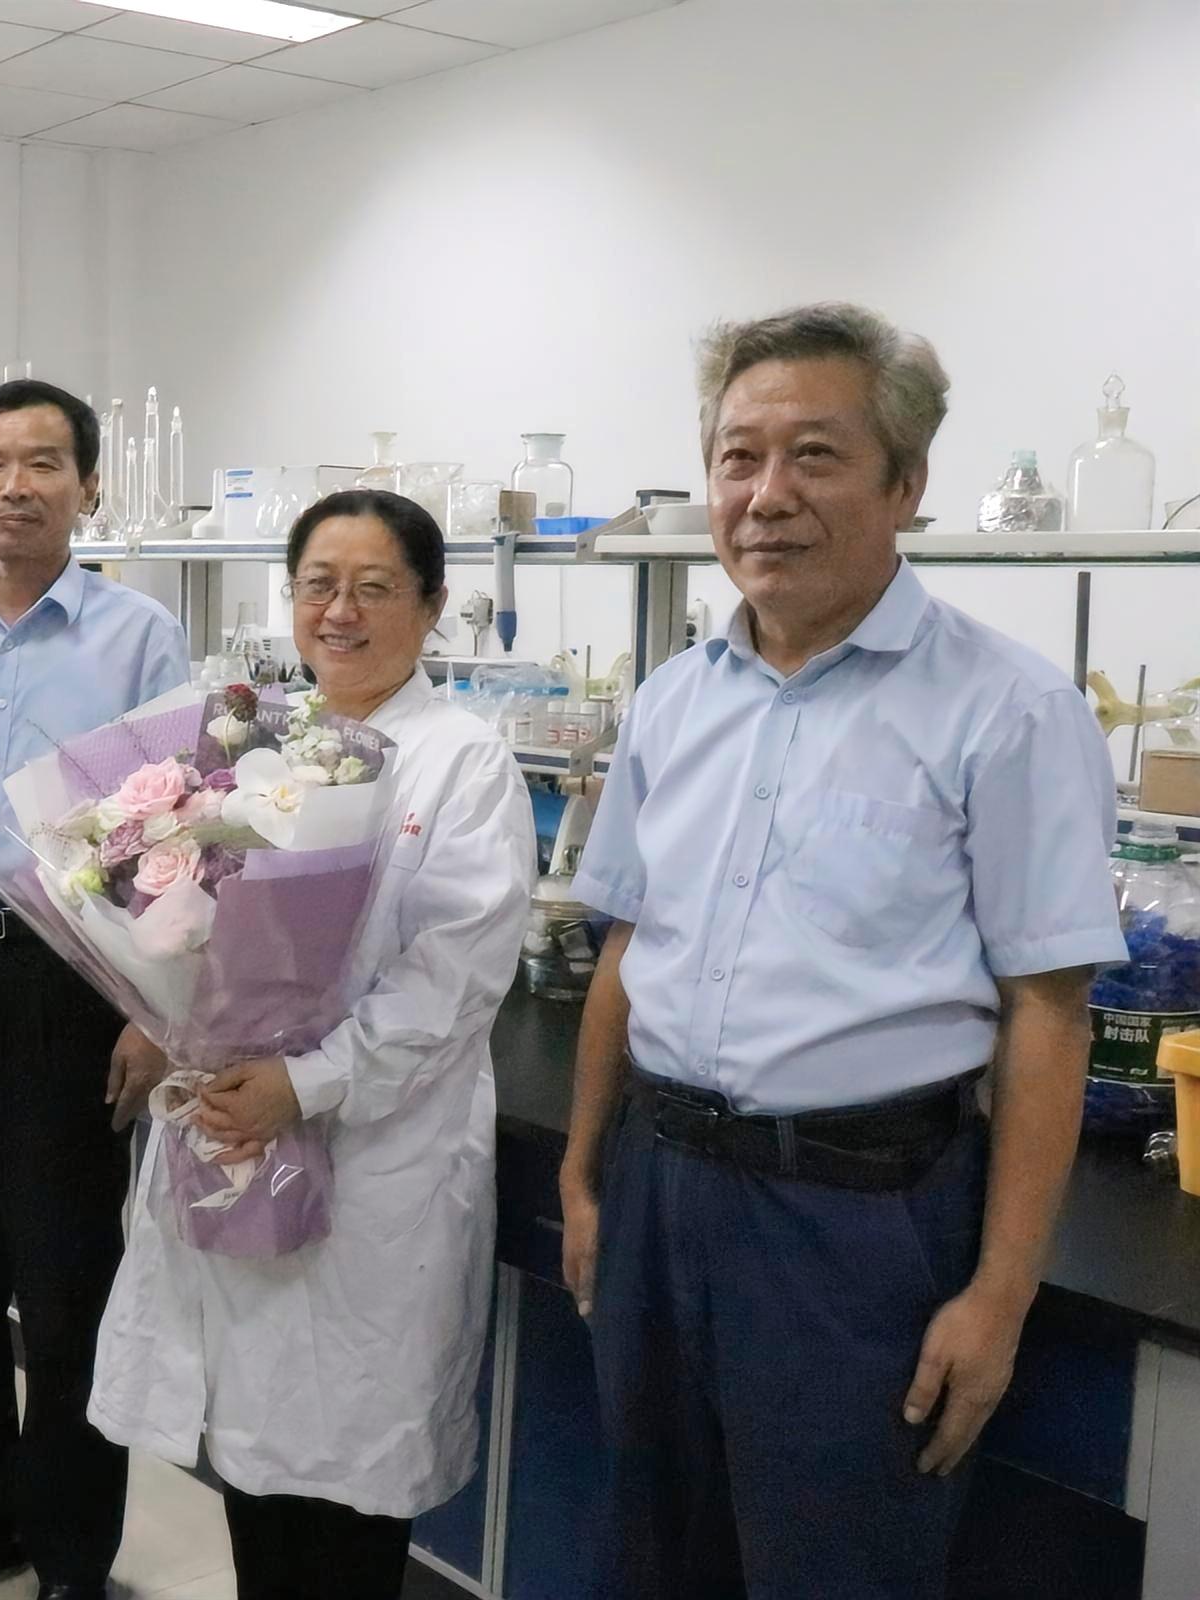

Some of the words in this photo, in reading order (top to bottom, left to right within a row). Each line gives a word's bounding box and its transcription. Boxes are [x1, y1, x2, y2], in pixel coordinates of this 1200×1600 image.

[1103, 1013, 1152, 1027] 中国国家
[1103, 1025, 1150, 1043] 射击队
